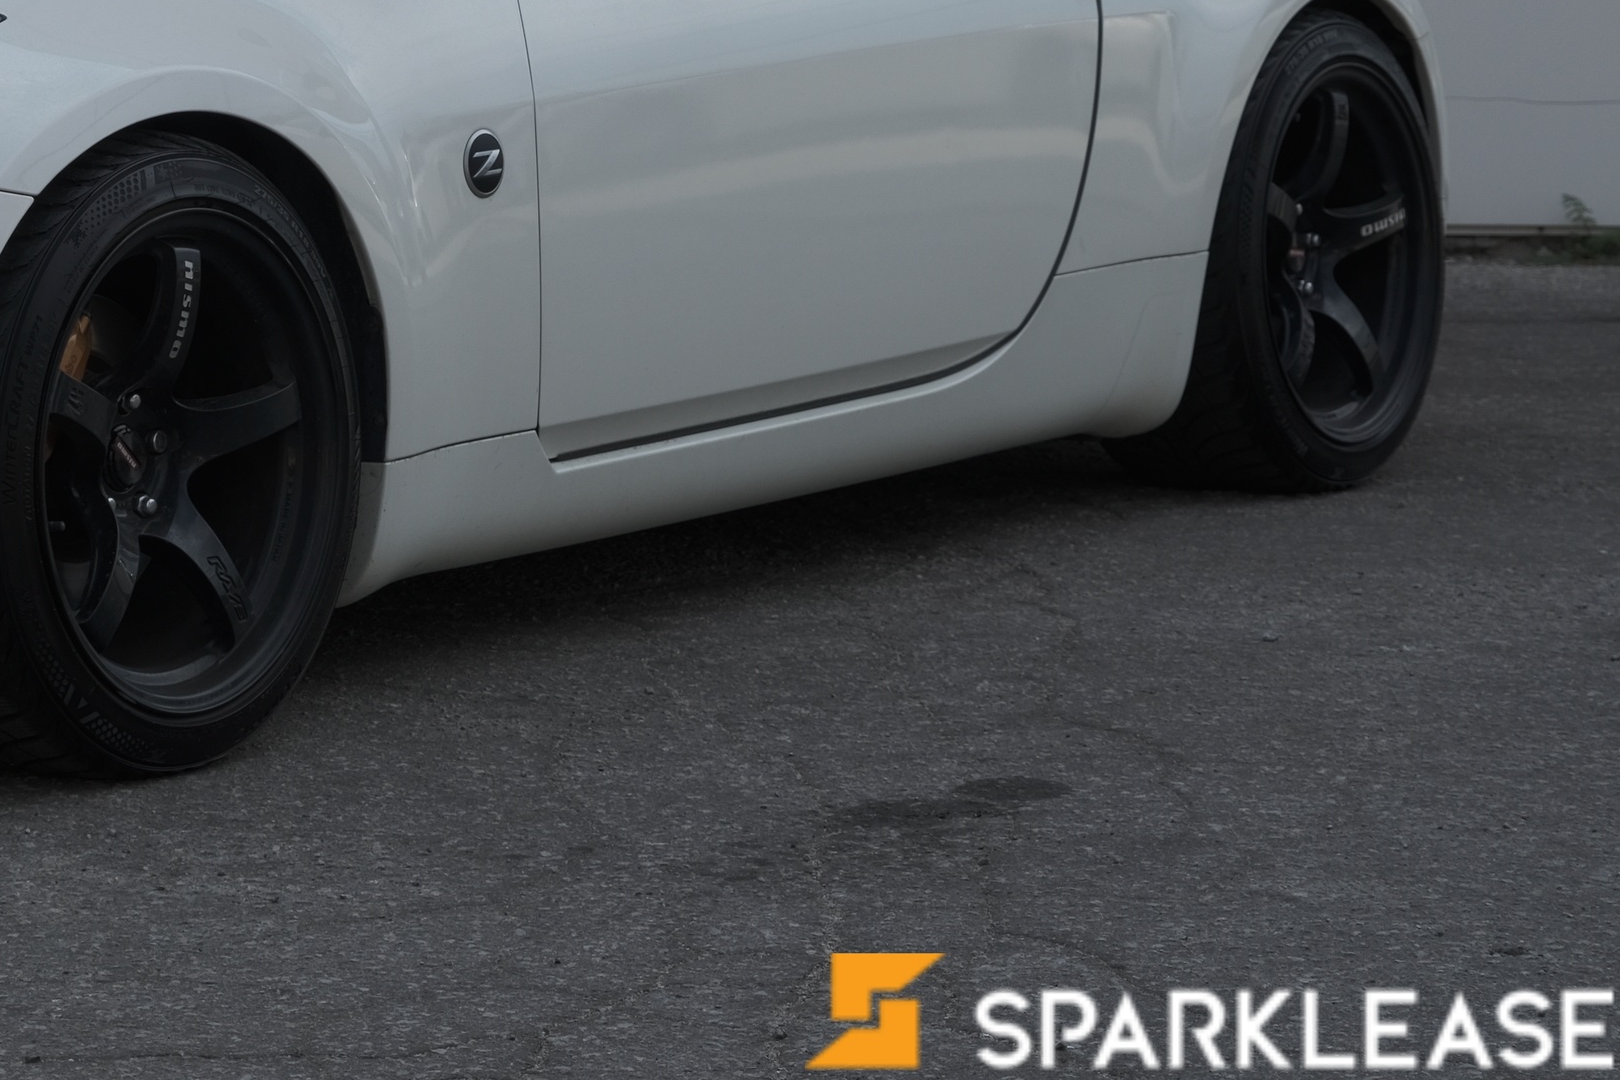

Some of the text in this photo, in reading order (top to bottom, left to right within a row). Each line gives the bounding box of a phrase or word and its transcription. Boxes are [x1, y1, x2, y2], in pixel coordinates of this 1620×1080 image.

[472, 149, 502, 179] Z
[169, 260, 194, 359] nismo
[207, 555, 249, 622] RAYS
